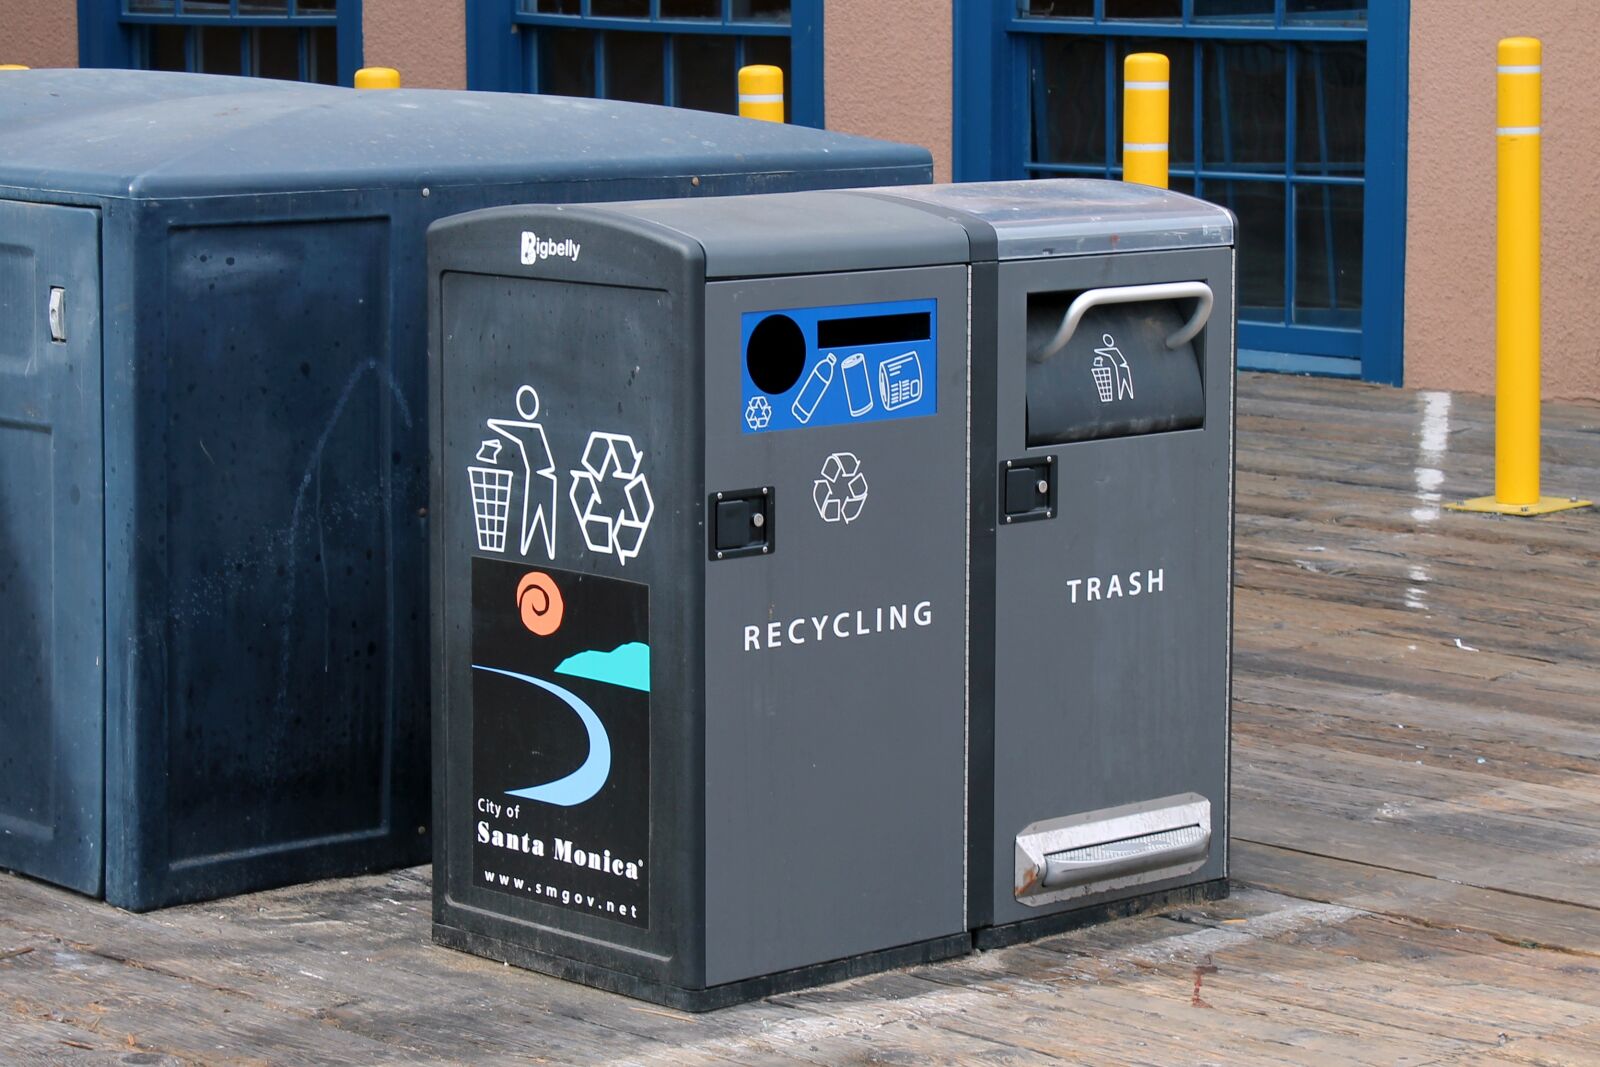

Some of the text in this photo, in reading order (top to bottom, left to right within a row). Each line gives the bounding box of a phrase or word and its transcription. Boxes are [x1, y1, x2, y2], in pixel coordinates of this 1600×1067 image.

[521, 231, 580, 265] Bigbelly
[1066, 568, 1164, 603] TRASH
[744, 601, 932, 651] RECYCLING
[477, 798, 520, 819] City of
[477, 820, 545, 857] Santa
[484, 870, 637, 919] www.smgov.net
